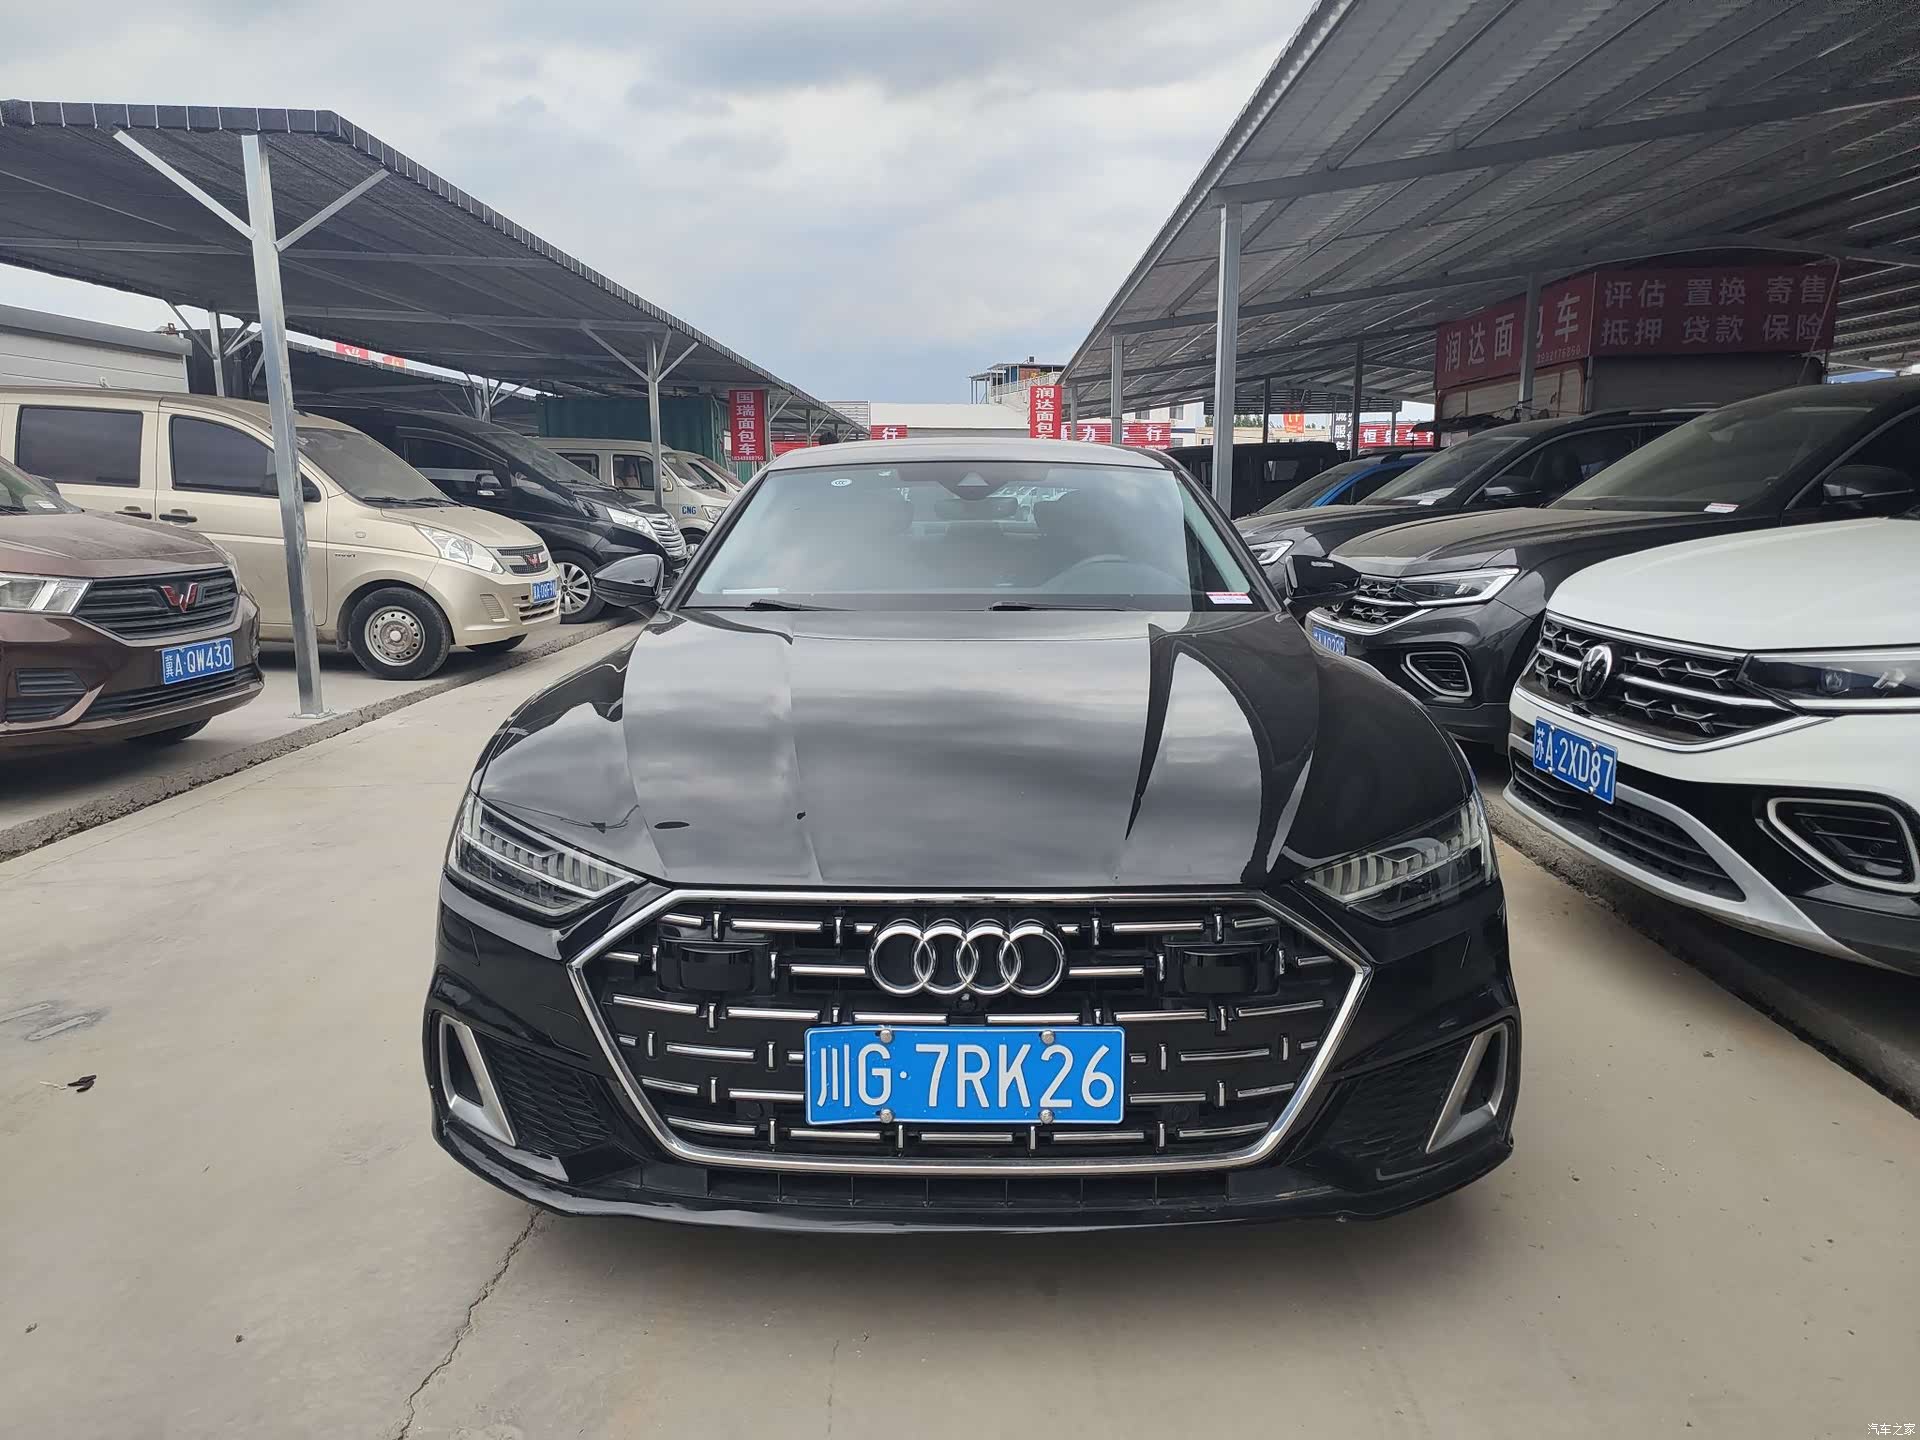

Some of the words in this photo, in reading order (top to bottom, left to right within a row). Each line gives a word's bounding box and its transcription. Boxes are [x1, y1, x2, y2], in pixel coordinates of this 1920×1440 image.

[1605, 279, 1667, 309] 评估
[1684, 277, 1746, 306] 置换
[1766, 274, 1828, 304] 寄售
[1601, 317, 1664, 346] 抵押
[1681, 314, 1745, 345] 贷款
[1762, 313, 1824, 343] 保险
[681, 505, 697, 515] CNG
[1535, 727, 1614, 793] 苏A·2XD87
[817, 1043, 1115, 1108] 川G·7RK26
